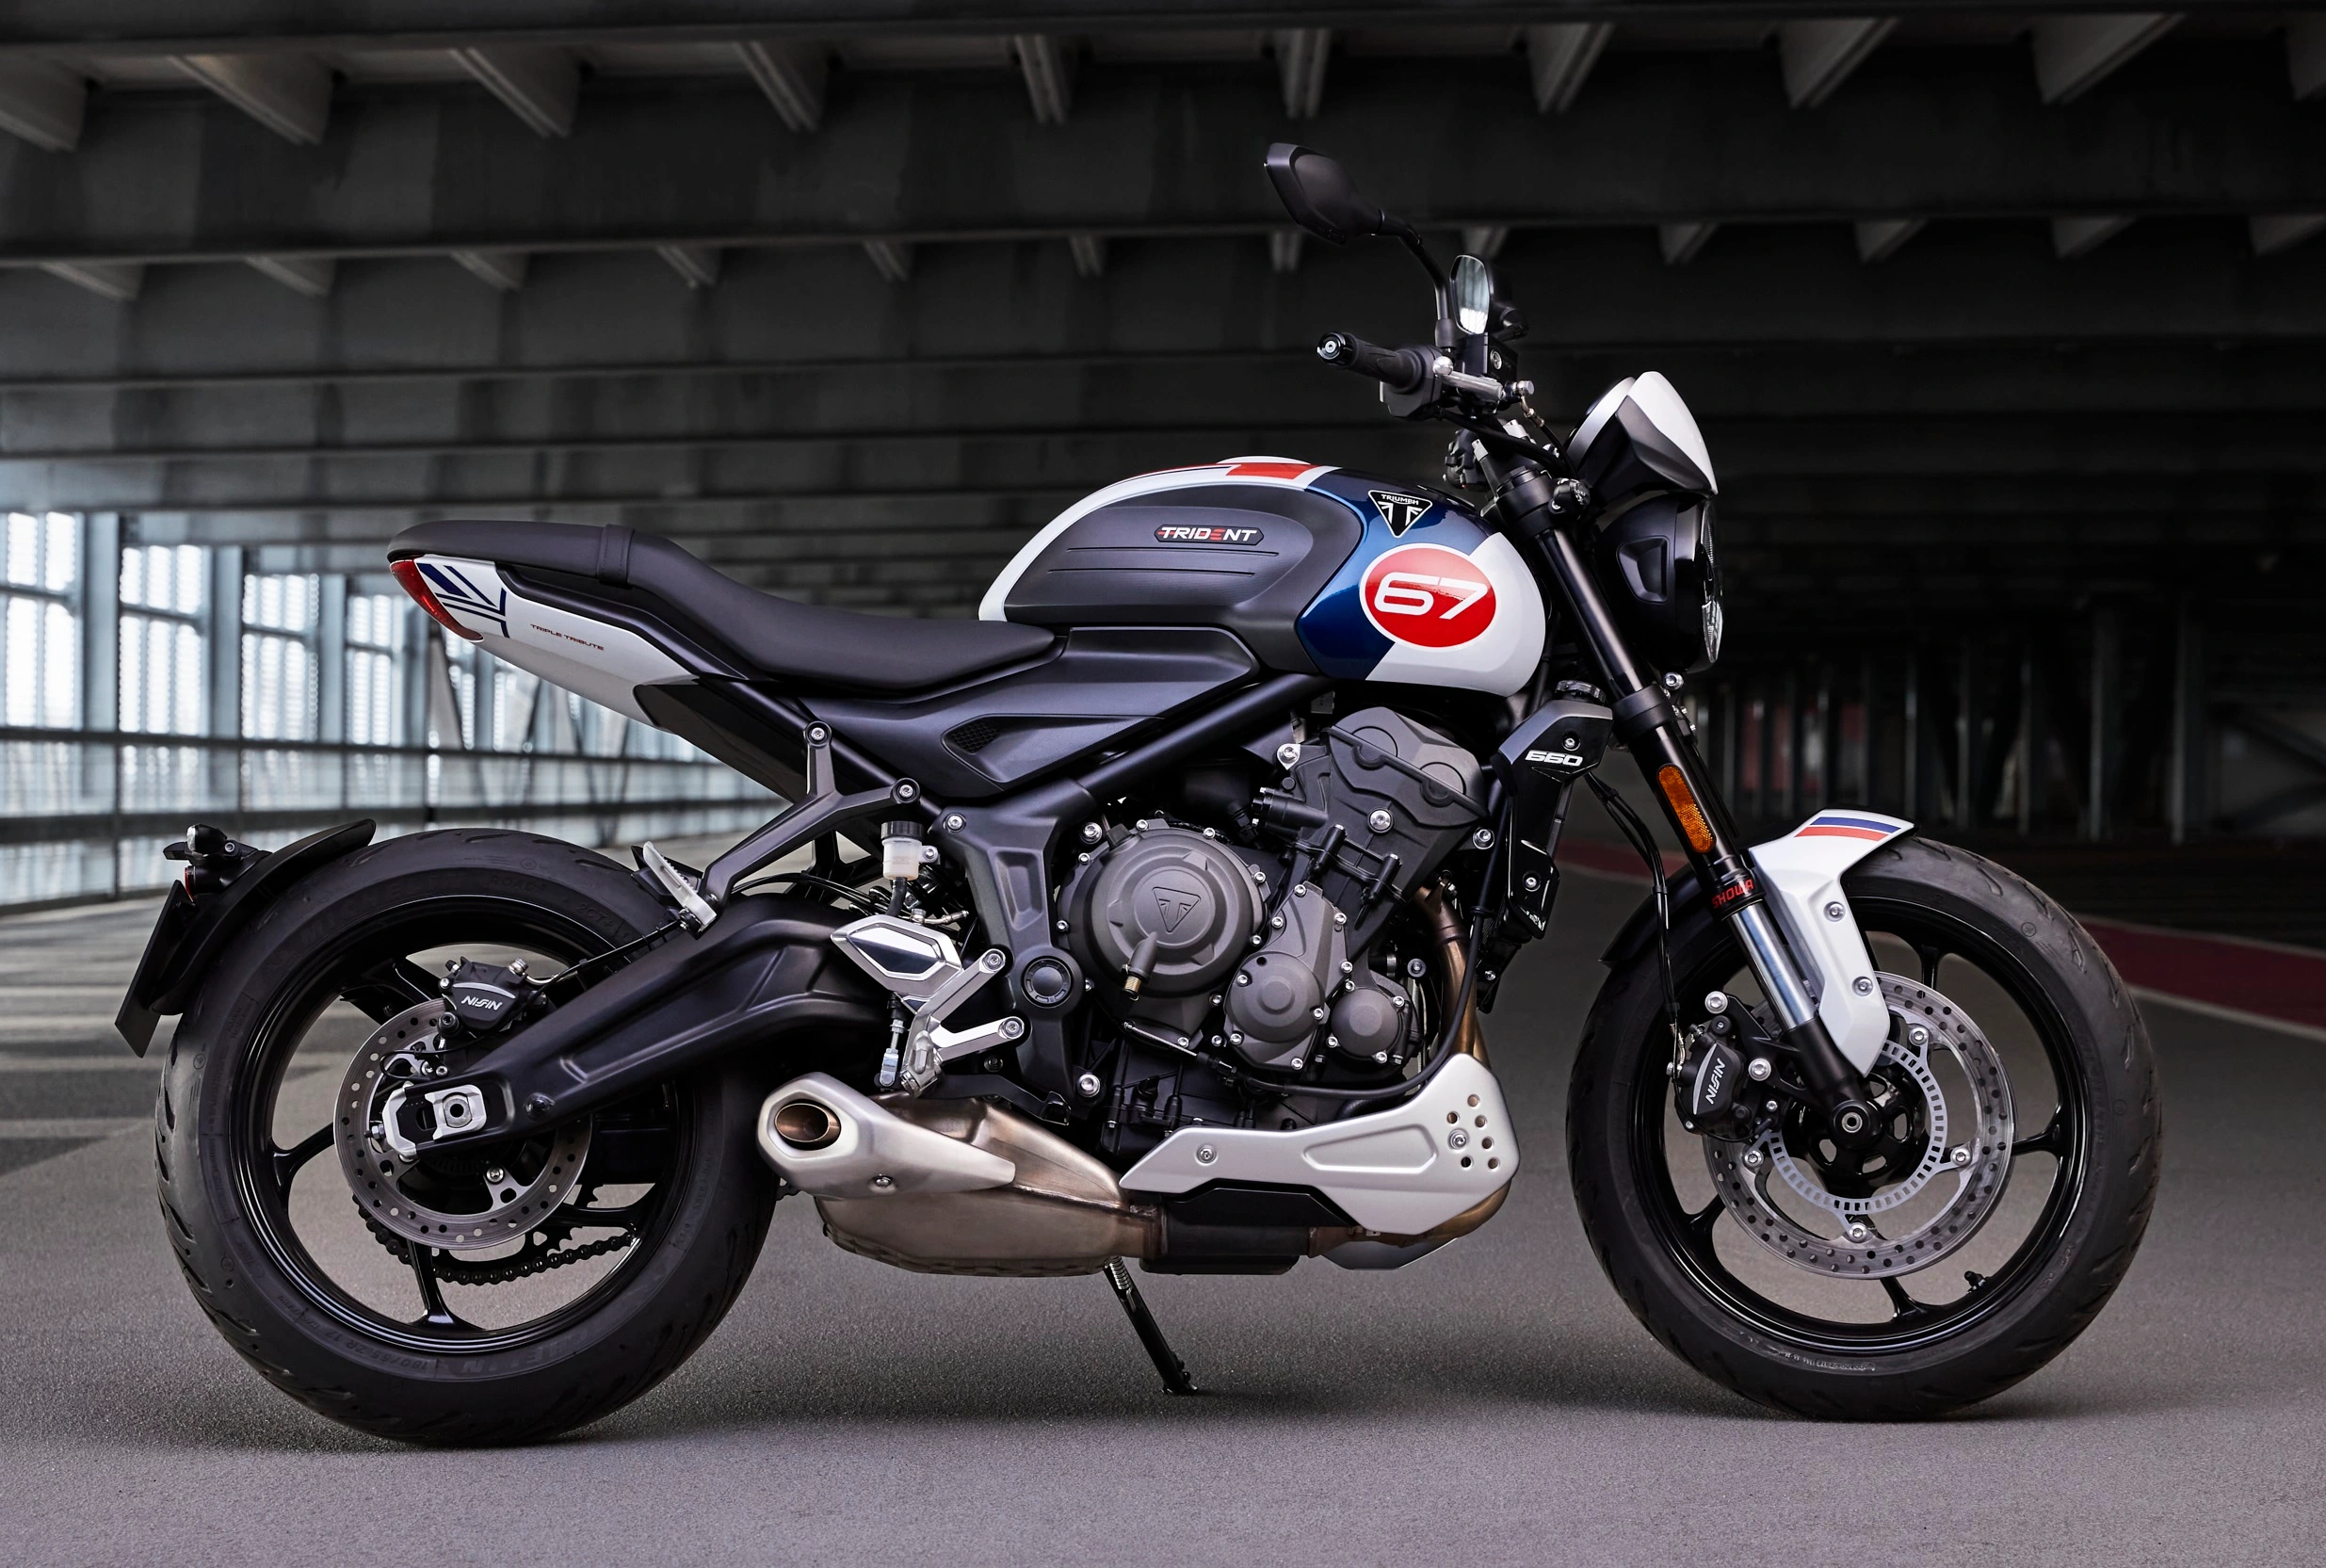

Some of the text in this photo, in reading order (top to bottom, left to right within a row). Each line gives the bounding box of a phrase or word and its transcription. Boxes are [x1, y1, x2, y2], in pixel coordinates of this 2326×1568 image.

[1381, 493, 1419, 506] TRIUMPH
[1158, 526, 1257, 542] TRIDENT
[1374, 572, 1488, 620] 67
[530, 623, 605, 651] TRIPLE TRIBUTE
[1526, 750, 1583, 767] 660
[1712, 879, 1754, 909] SHOWA
